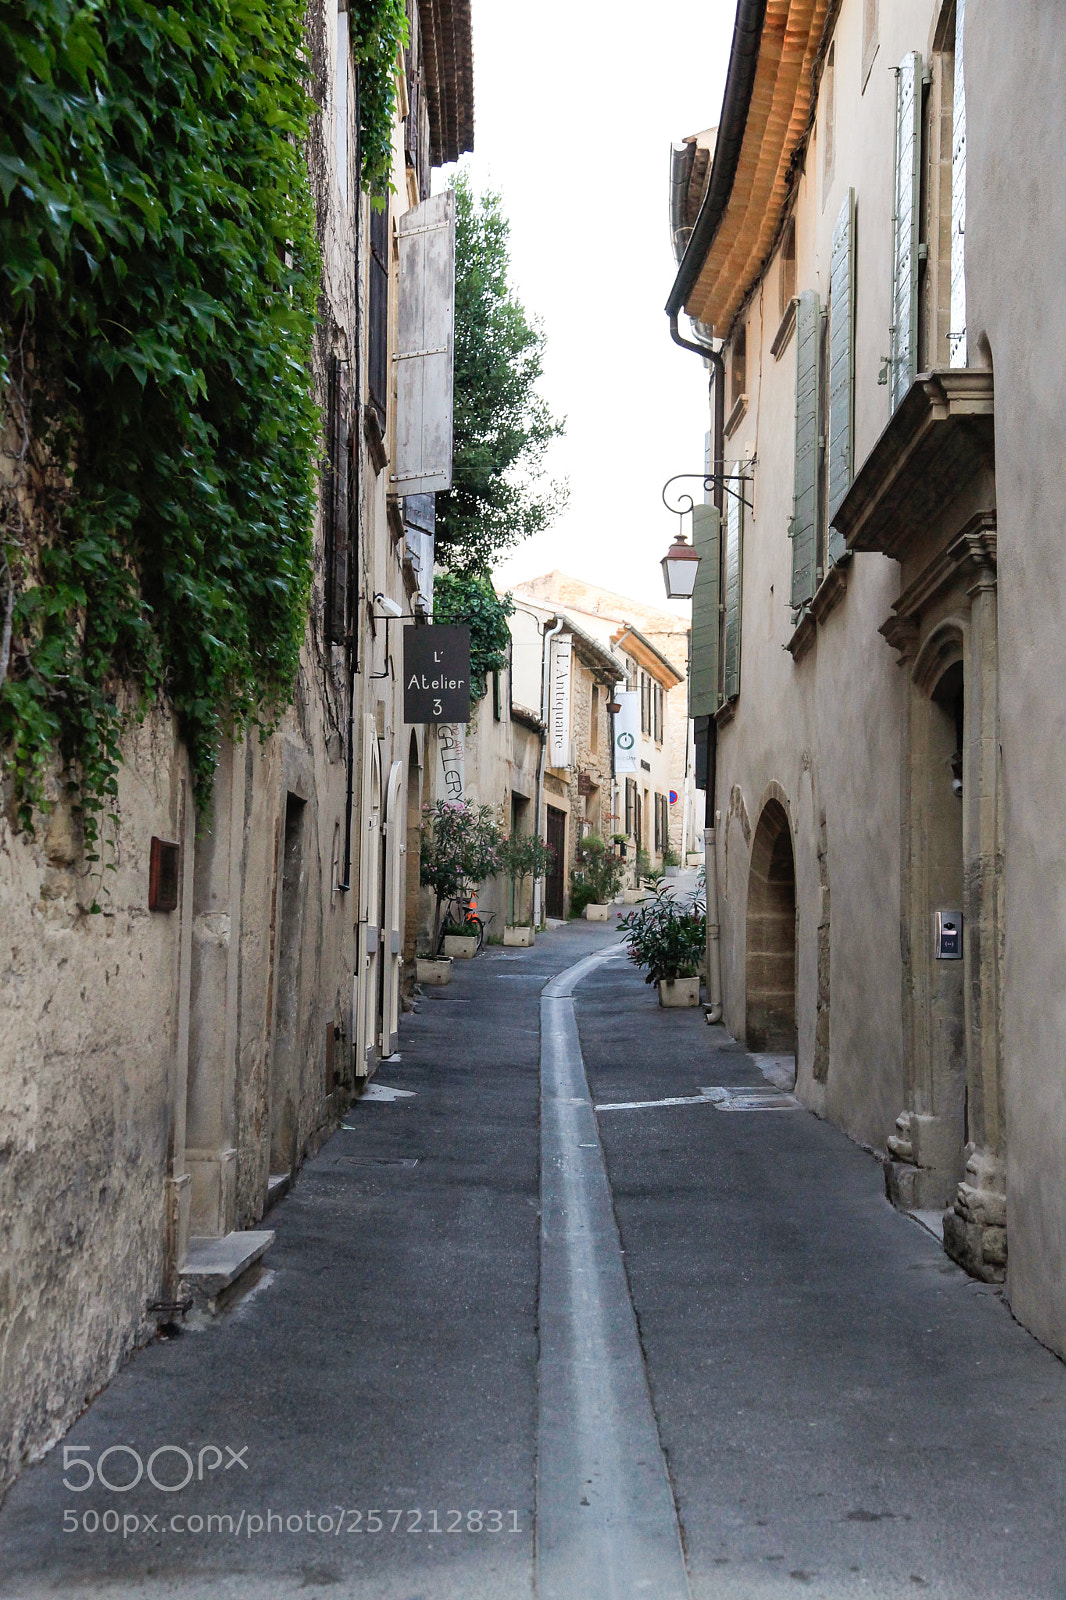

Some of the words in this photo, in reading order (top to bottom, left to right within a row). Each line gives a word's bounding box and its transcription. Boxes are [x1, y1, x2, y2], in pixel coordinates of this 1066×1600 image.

[407, 674, 465, 690] Atelier
[552, 654, 569, 749] L'Antiquaire
[432, 698, 443, 716] 3
[437, 725, 464, 803] GALLERY
